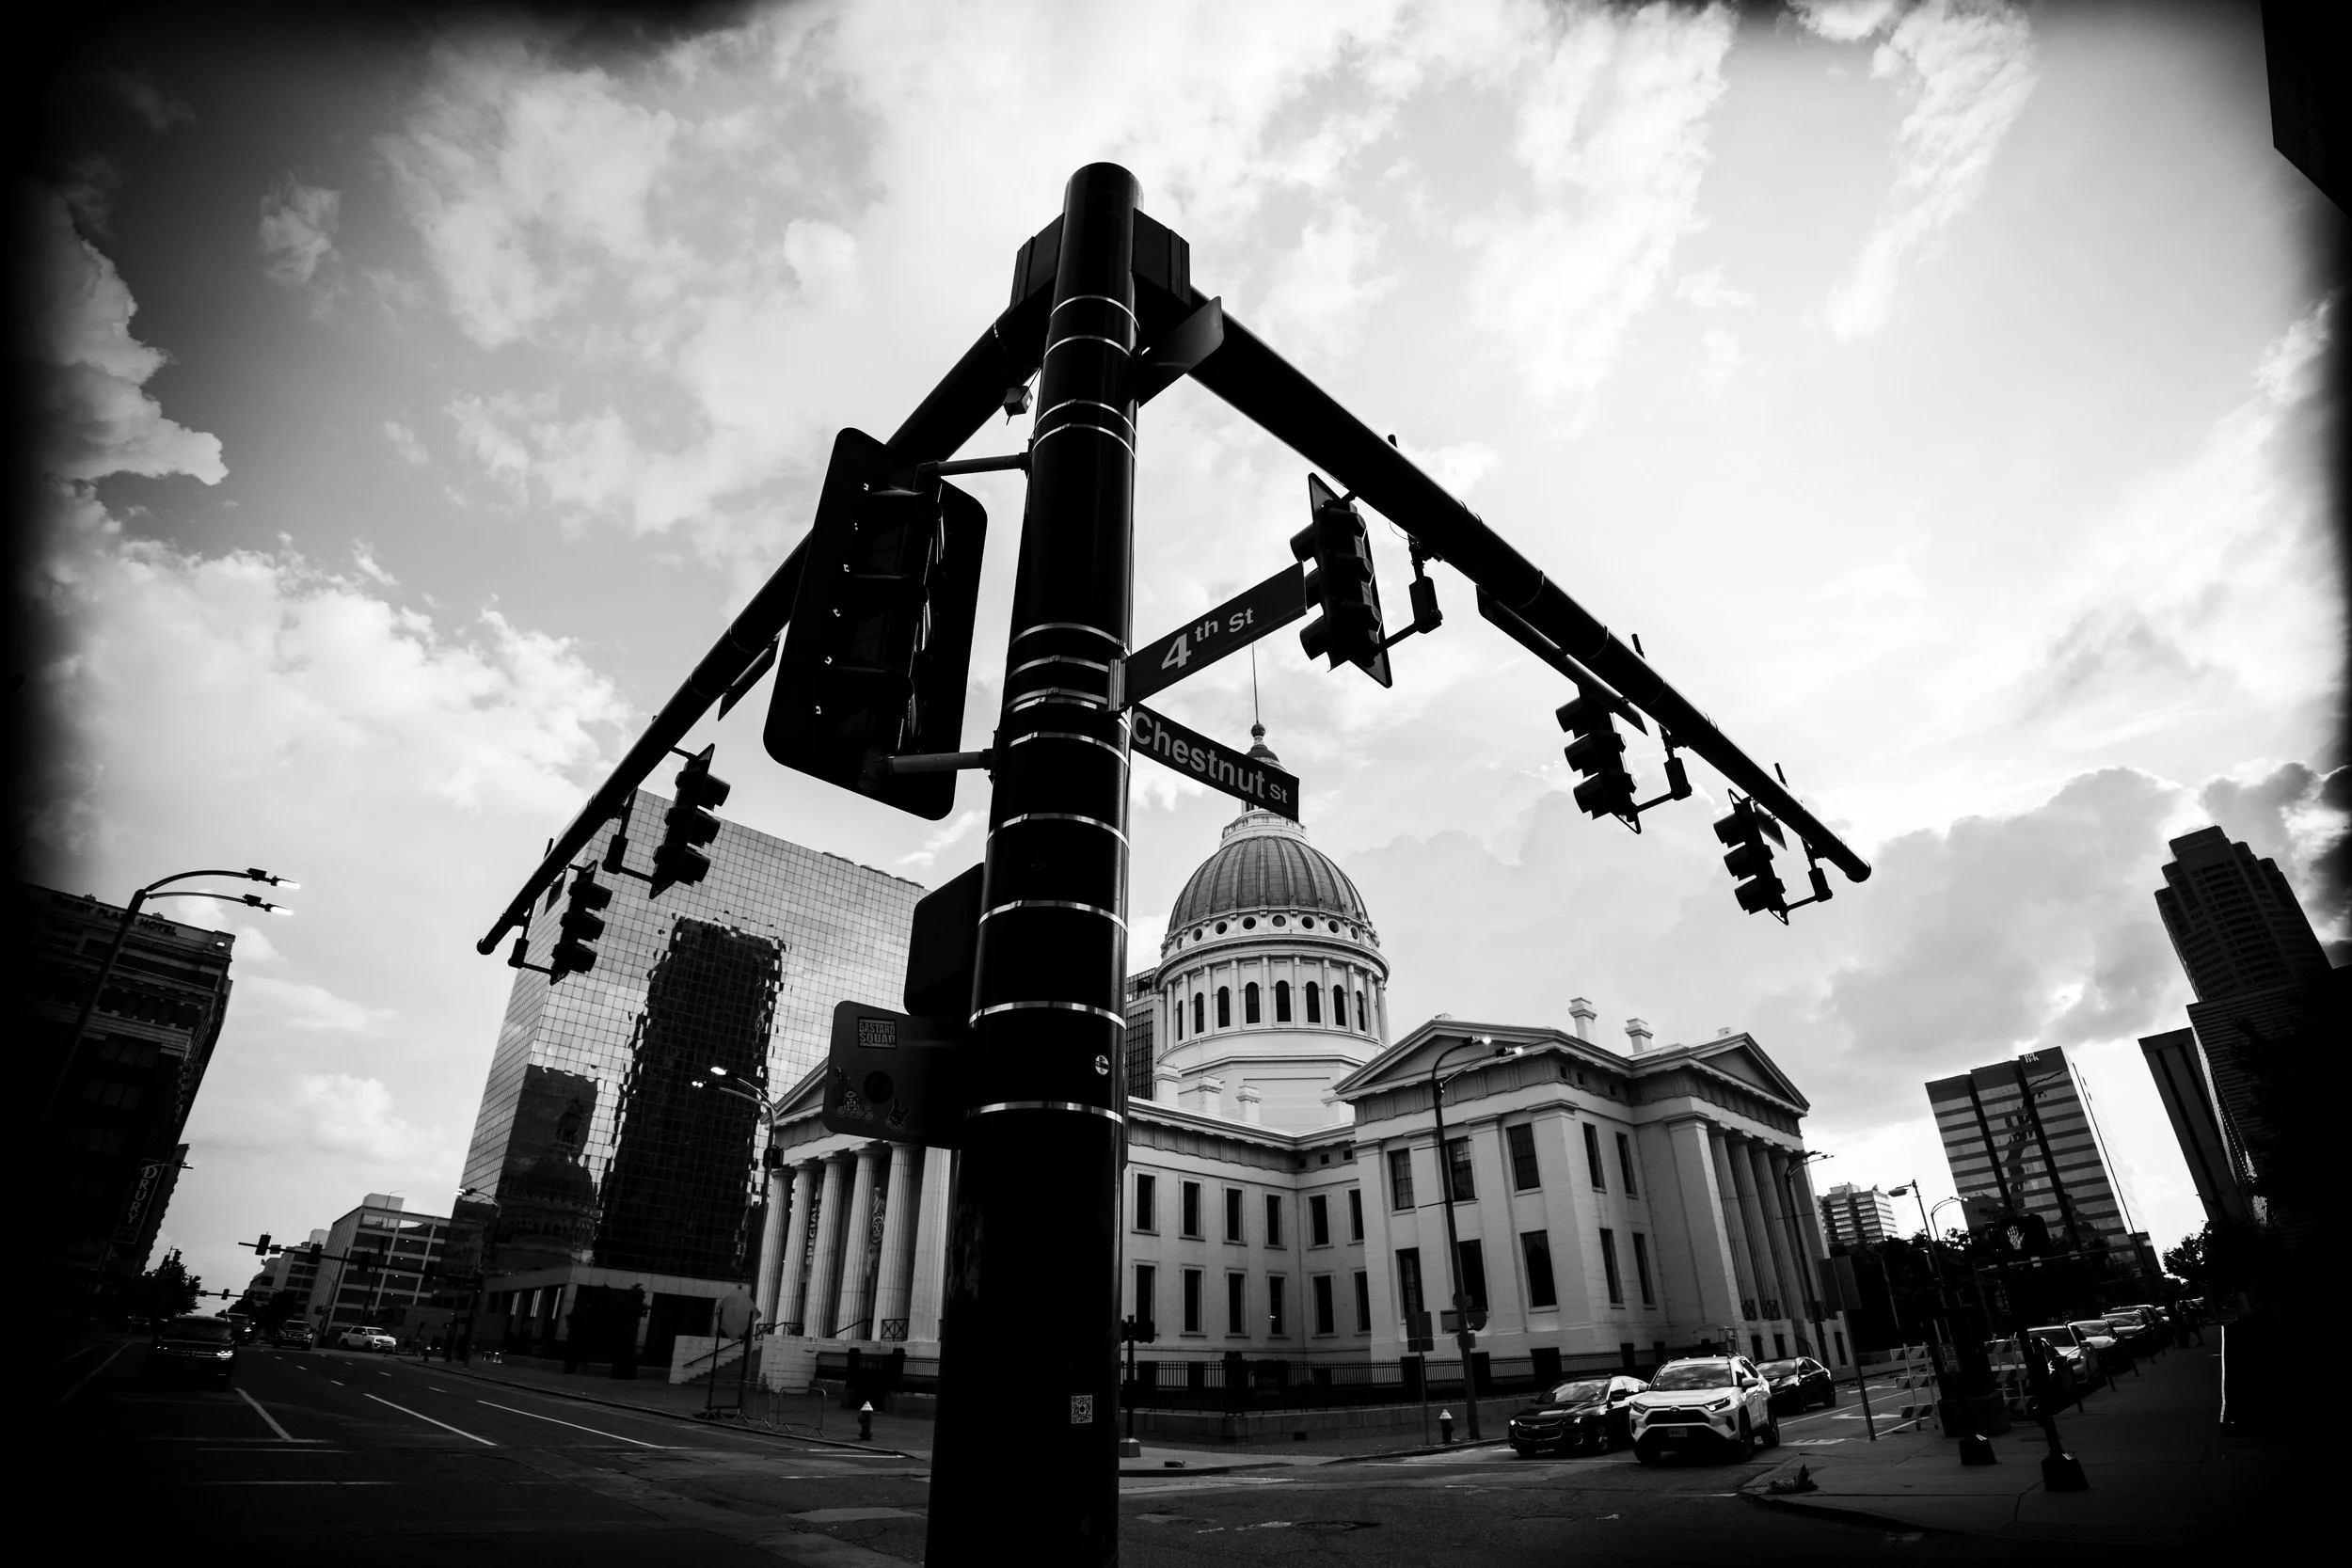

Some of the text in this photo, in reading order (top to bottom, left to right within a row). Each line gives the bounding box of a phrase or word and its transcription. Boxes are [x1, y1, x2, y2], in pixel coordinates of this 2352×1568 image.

[1161, 608, 1254, 671] 4th St
[1131, 711, 1288, 804] Chestnut St
[139, 917, 177, 936] HOTEL
[859, 1022, 895, 1034] BASTARD
[128, 1165, 158, 1224] DRURY
